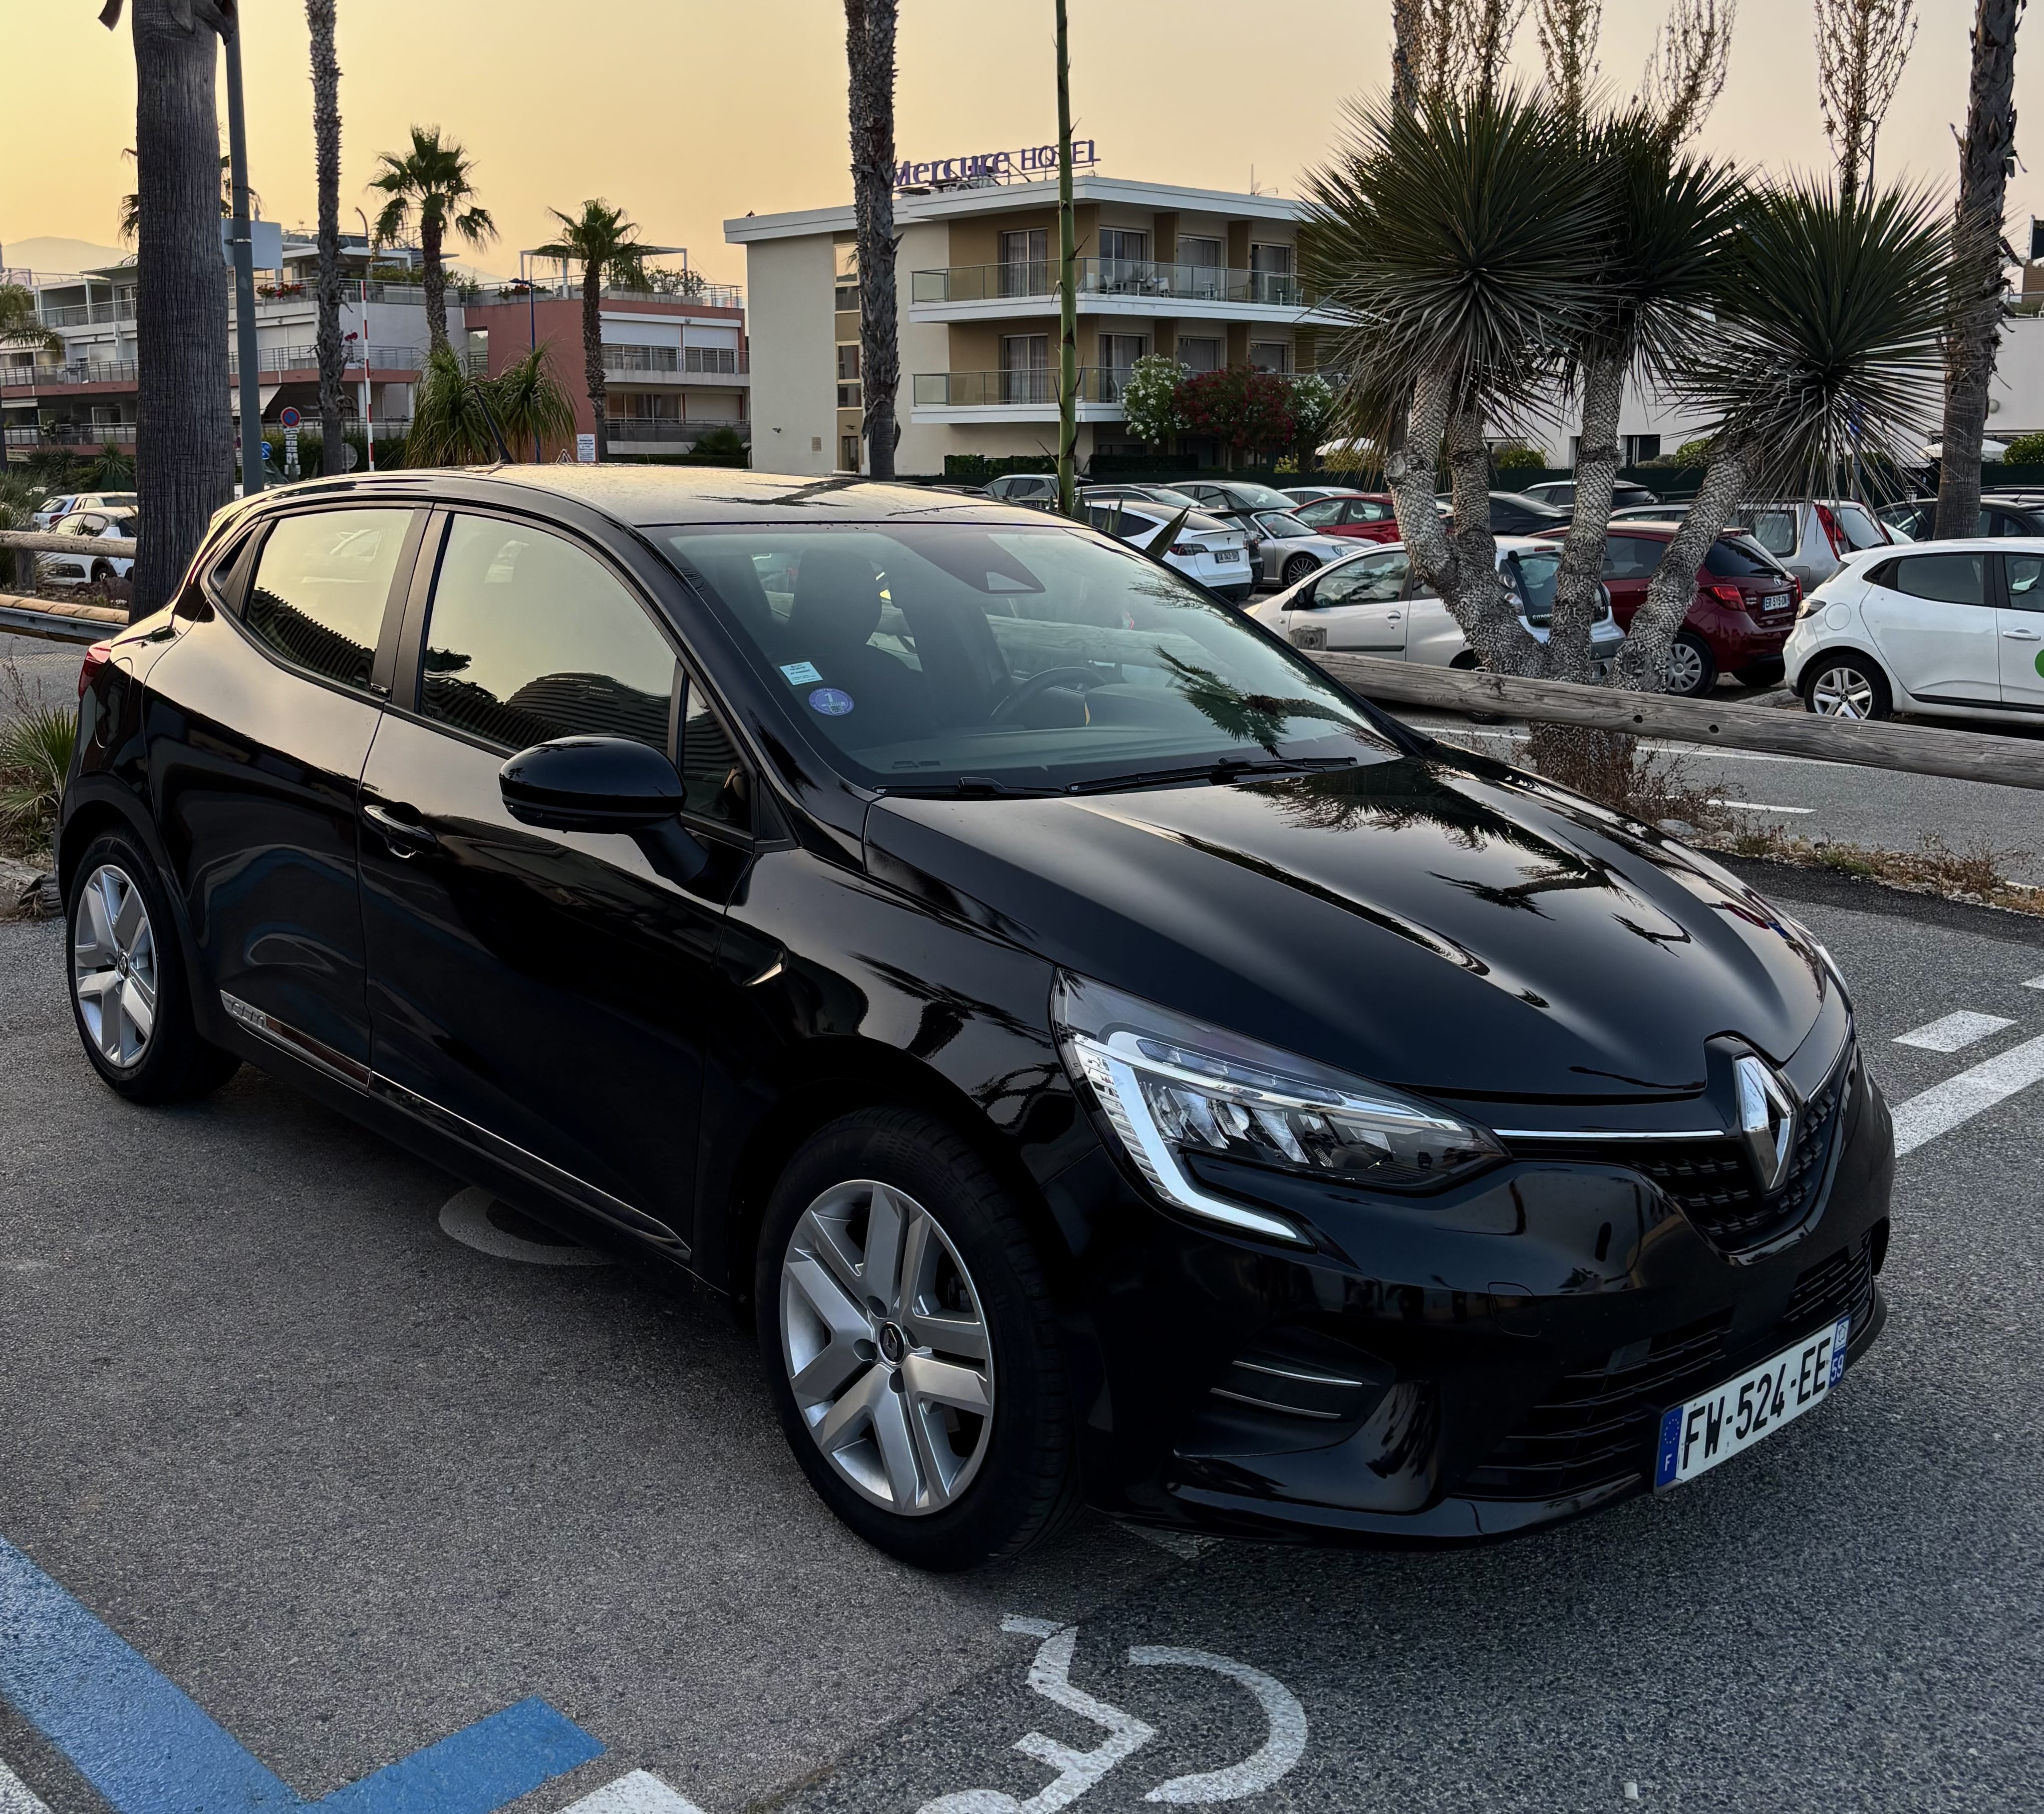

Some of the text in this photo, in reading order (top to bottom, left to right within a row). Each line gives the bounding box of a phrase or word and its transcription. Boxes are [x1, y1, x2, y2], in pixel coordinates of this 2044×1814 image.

[894, 140, 1101, 186] Mercure HOEL
[824, 693, 834, 703] 1
[231, 1002, 264, 1028] CLIO
[1831, 1354, 1844, 1382] 59
[1682, 1337, 1831, 1470] FW-524-EE
[1664, 1453, 1672, 1471] F
